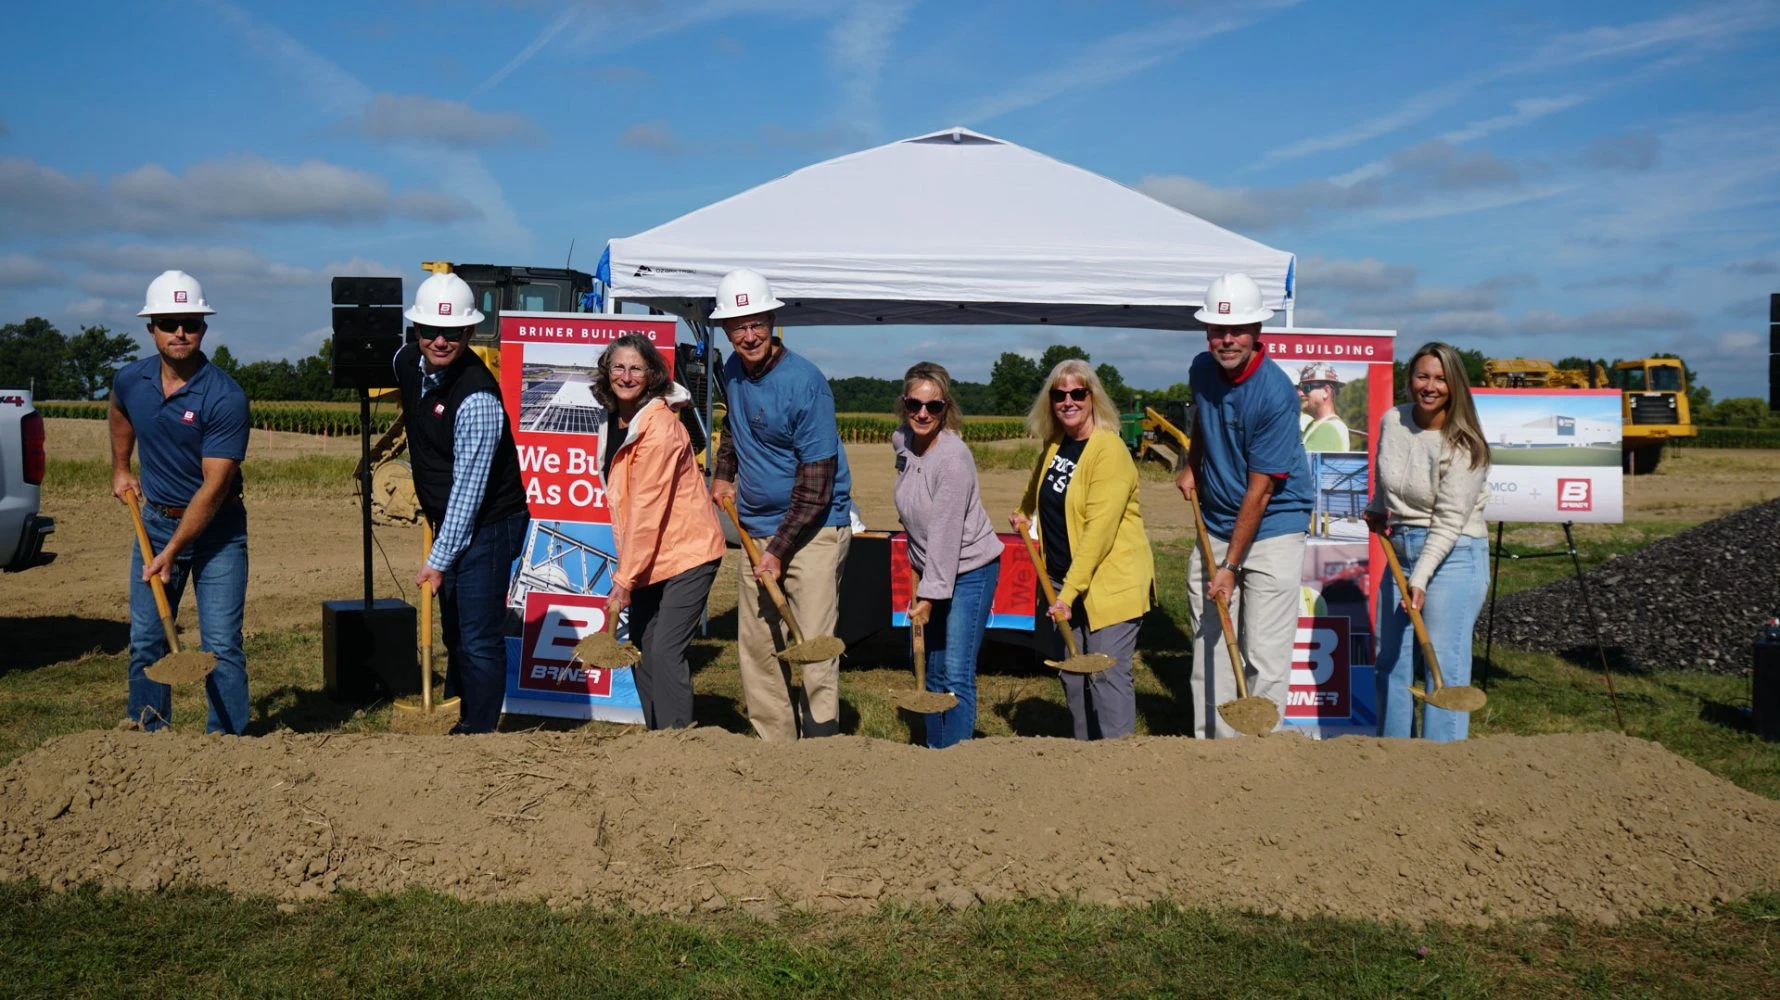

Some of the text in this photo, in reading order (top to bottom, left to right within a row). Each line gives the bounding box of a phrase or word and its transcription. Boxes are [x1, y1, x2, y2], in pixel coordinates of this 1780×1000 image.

[519, 326, 657, 341] BRINER BUILDG
[1267, 343, 1375, 356] ER BUILDING
[515, 445, 561, 474] We
[526, 477, 561, 505] As
[1561, 481, 1588, 501] B
[531, 604, 606, 663] B
[1289, 628, 1339, 685] B
[530, 665, 601, 684] BRINER
